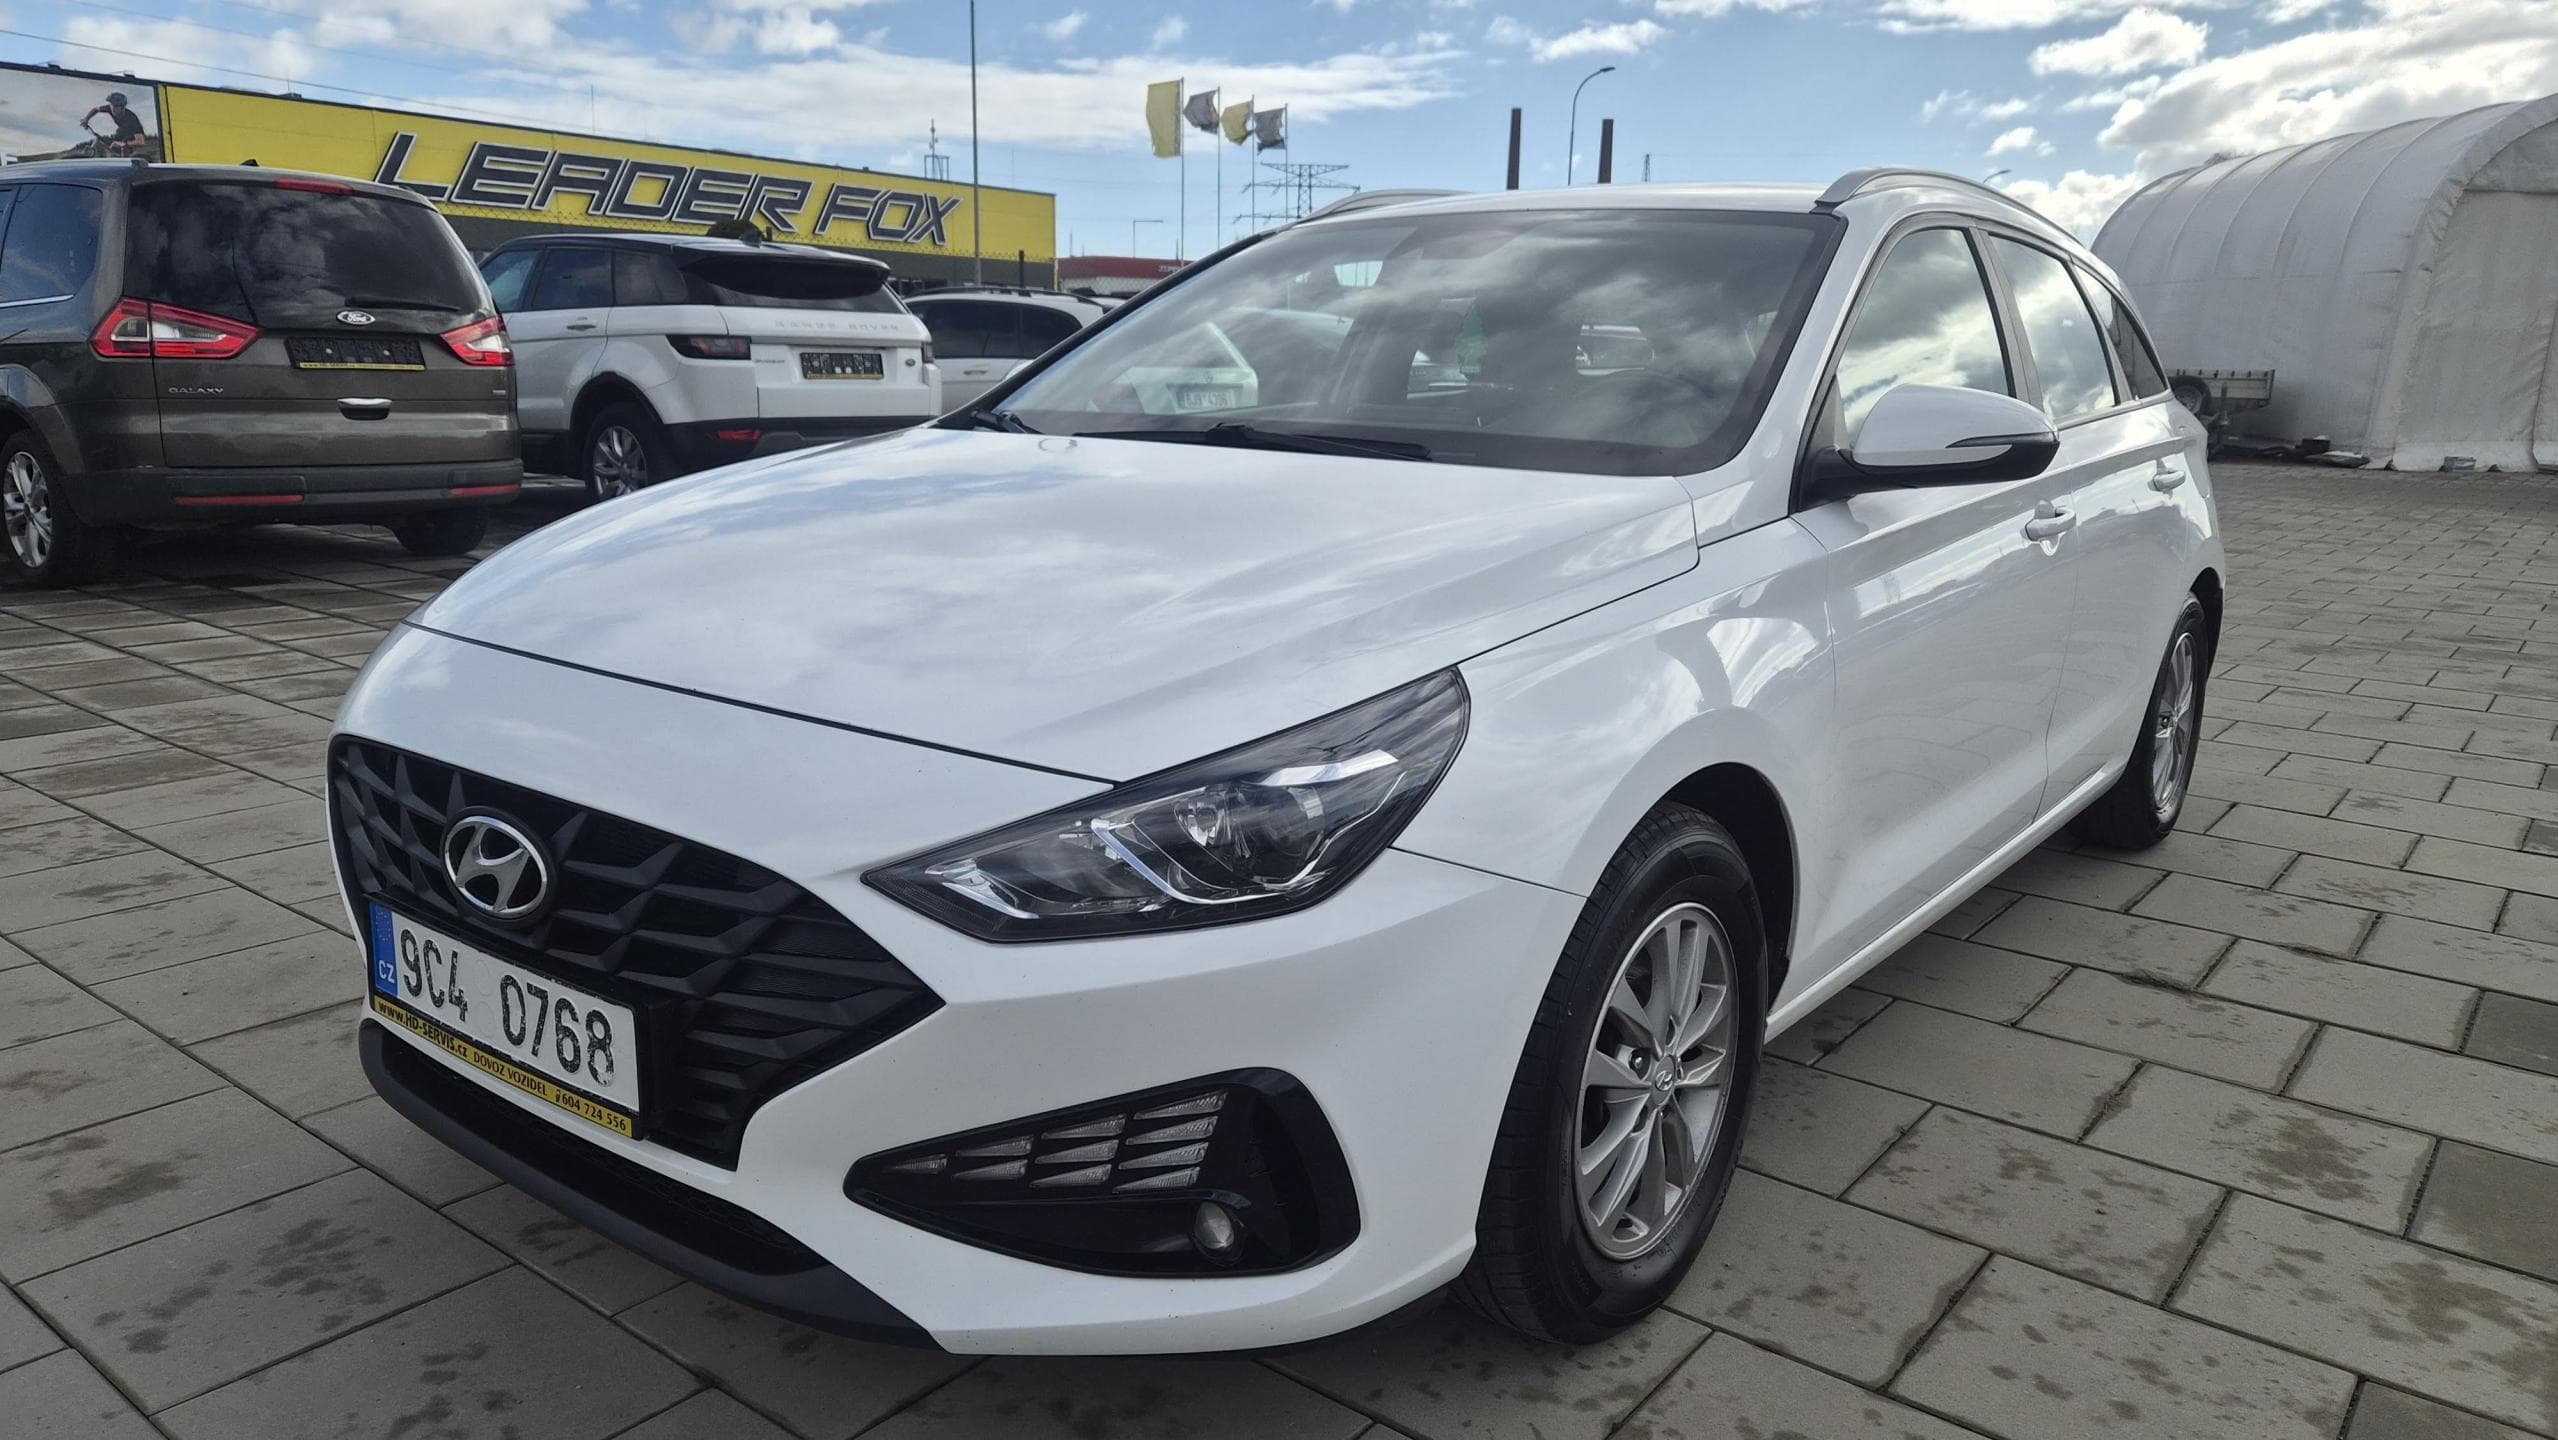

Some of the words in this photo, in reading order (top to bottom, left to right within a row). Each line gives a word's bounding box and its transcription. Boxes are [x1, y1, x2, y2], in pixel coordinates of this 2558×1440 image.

[374, 131, 815, 233] LEADER
[813, 183, 964, 246] FOX
[168, 386, 224, 394] GALAXY
[379, 960, 395, 984] CZ
[400, 929, 468, 1022] 9C4
[500, 974, 614, 1086] 0768
[473, 1051, 506, 1076] DOVOZ
[507, 1067, 548, 1097] VOZIDEL
[562, 1093, 581, 1111] 604
[584, 1102, 603, 1121] 724
[606, 1112, 627, 1132] 556
